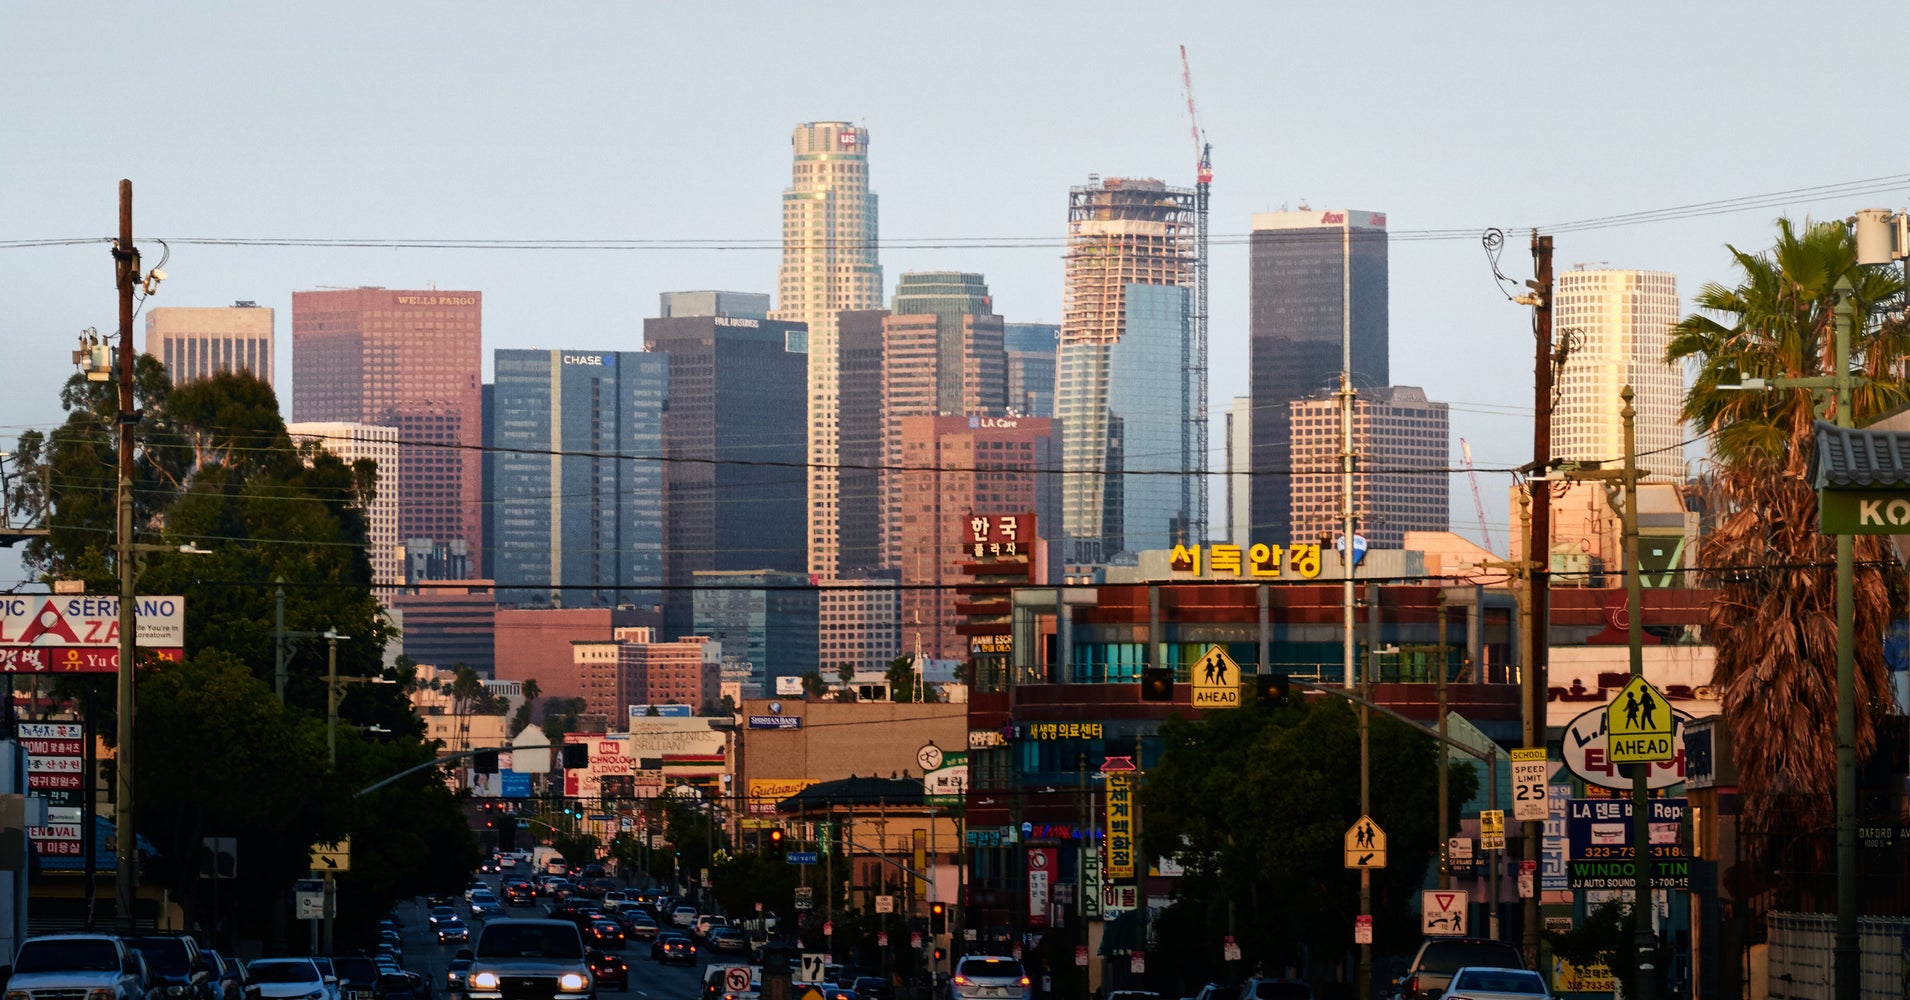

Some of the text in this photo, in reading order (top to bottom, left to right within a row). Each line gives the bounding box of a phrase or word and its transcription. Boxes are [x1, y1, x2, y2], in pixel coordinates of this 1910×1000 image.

[398, 296, 476, 306] WELLS FARGO
[563, 355, 602, 366] CHASE
[996, 419, 1018, 428] Care
[1170, 543, 1322, 579] 서독안경
[1196, 691, 1237, 703] AHEAD
[1613, 740, 1670, 756] AHEAD
[1517, 784, 1545, 800] 25
[1573, 803, 1592, 818] LA
[1859, 827, 1893, 839] OXFORD
[788, 854, 817, 862] Harvard
[1574, 862, 1653, 877] WINDO
[1584, 879, 1606, 888] AUTO
[1608, 878, 1636, 888] SOUND
